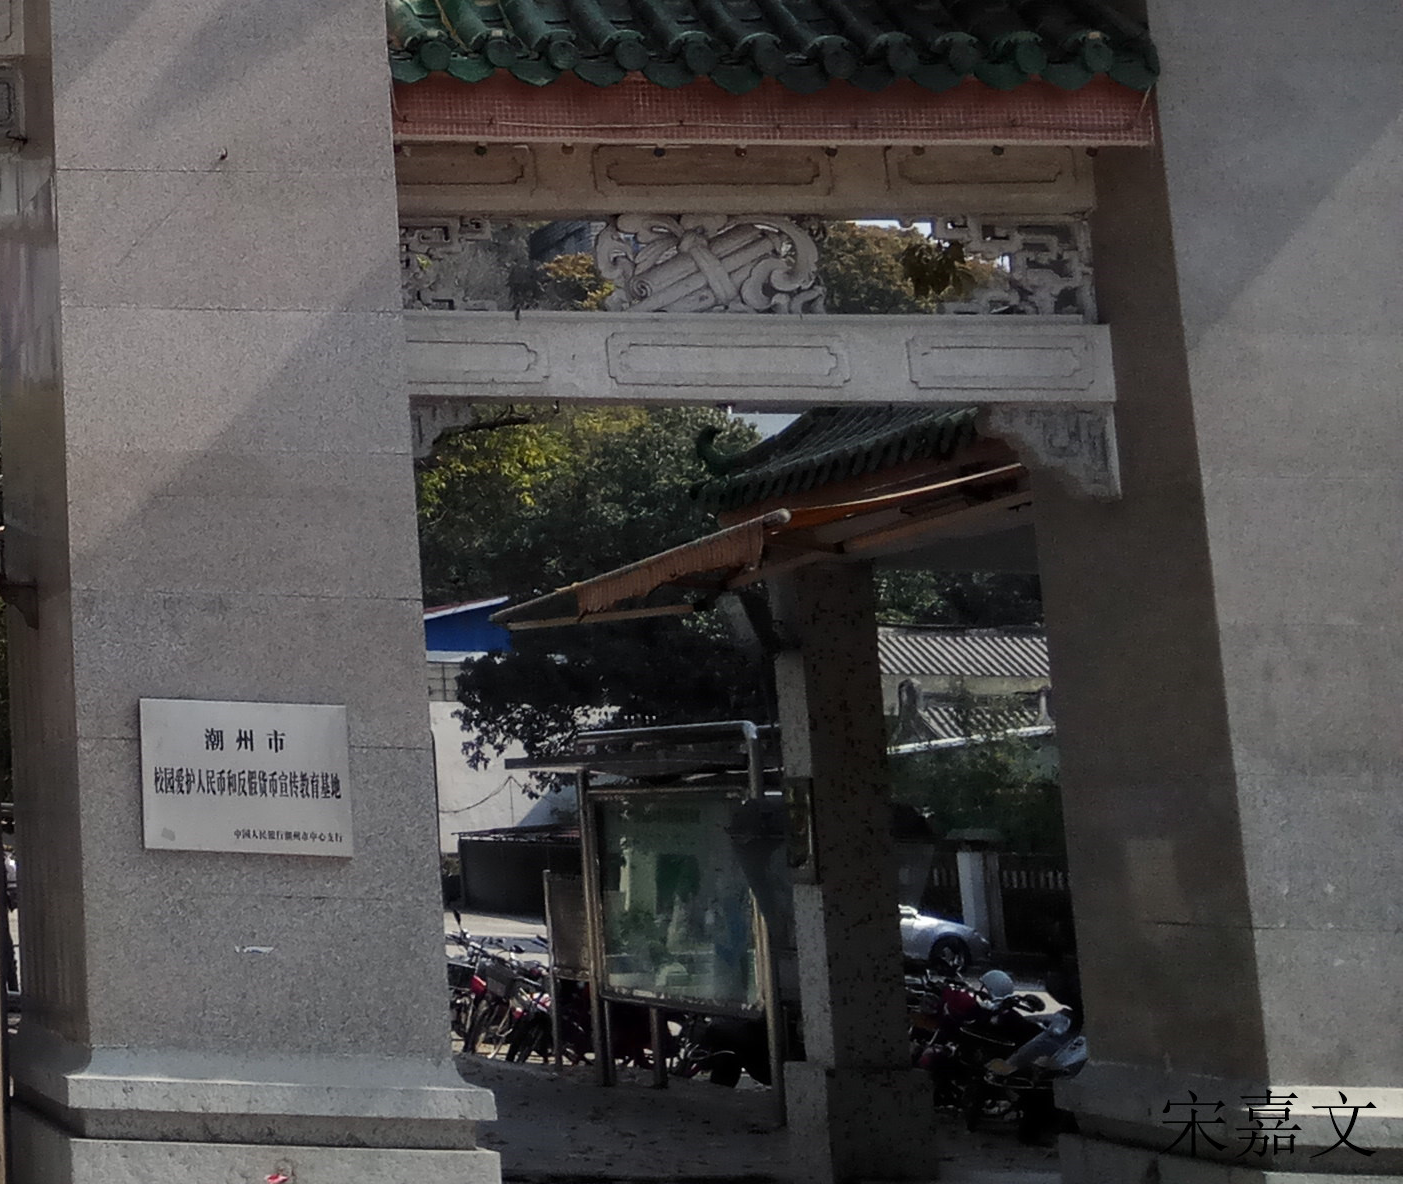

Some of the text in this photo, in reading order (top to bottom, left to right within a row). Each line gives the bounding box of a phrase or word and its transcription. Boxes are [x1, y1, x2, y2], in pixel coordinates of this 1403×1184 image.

[204, 727, 286, 754] 潮州市
[153, 766, 342, 800] 校园爱护人民币和反假货币宣传教育基地
[233, 828, 343, 843] 中国人民银行潮州市中心支行
